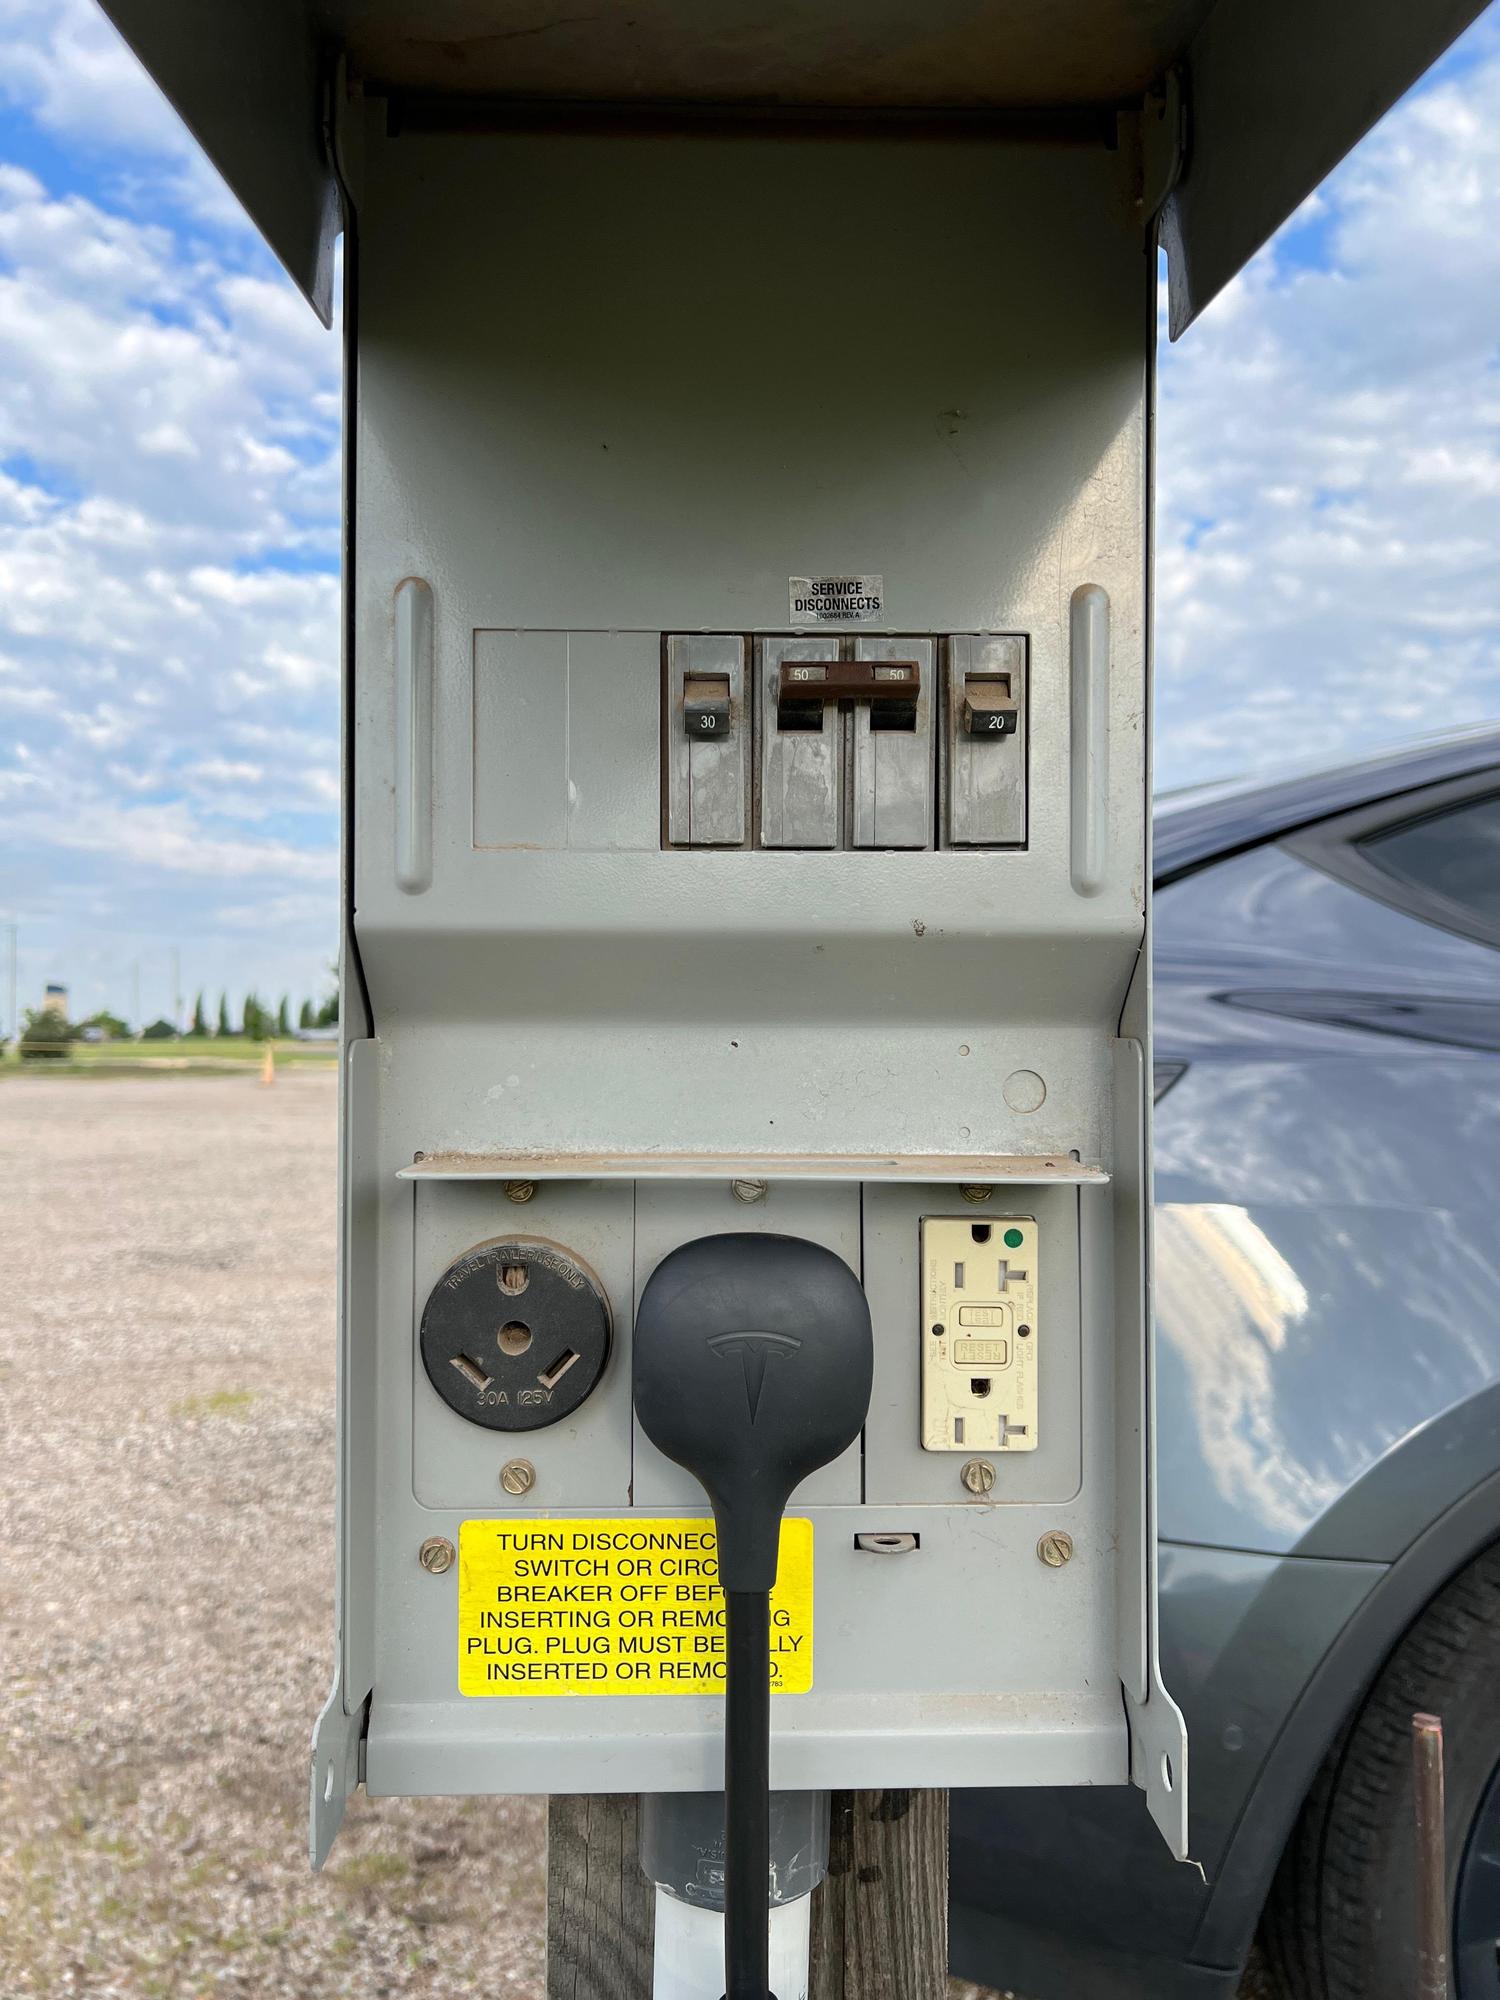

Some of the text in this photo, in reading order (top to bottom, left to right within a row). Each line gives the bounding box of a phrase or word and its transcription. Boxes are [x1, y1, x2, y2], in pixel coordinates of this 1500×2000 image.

[811, 582, 863, 596] SERVICE
[795, 597, 880, 611] DISCONNECTS
[794, 669, 809, 681] 50
[889, 669, 905, 681] 50
[700, 715, 716, 729] 30
[989, 716, 1004, 729] 20
[444, 1248, 585, 1290] TRAVEL TRAILER USE ONLY
[961, 1343, 1000, 1351] RESET
[476, 1390, 554, 1406] 30A 125V
[497, 1532, 716, 1551] TURN DISCONNEC
[514, 1558, 718, 1577] SWITCH OR CIRC
[498, 1584, 773, 1602] BREAKER OFF BEF
[480, 1609, 790, 1629] INSERTING OR REMOG
[468, 1637, 539, 1655] PLUG.
[547, 1637, 612, 1655] PLUG
[619, 1636, 687, 1654] MUST
[694, 1636, 725, 1653] BE
[487, 1661, 783, 1681] INSERTED OR REMOD.
